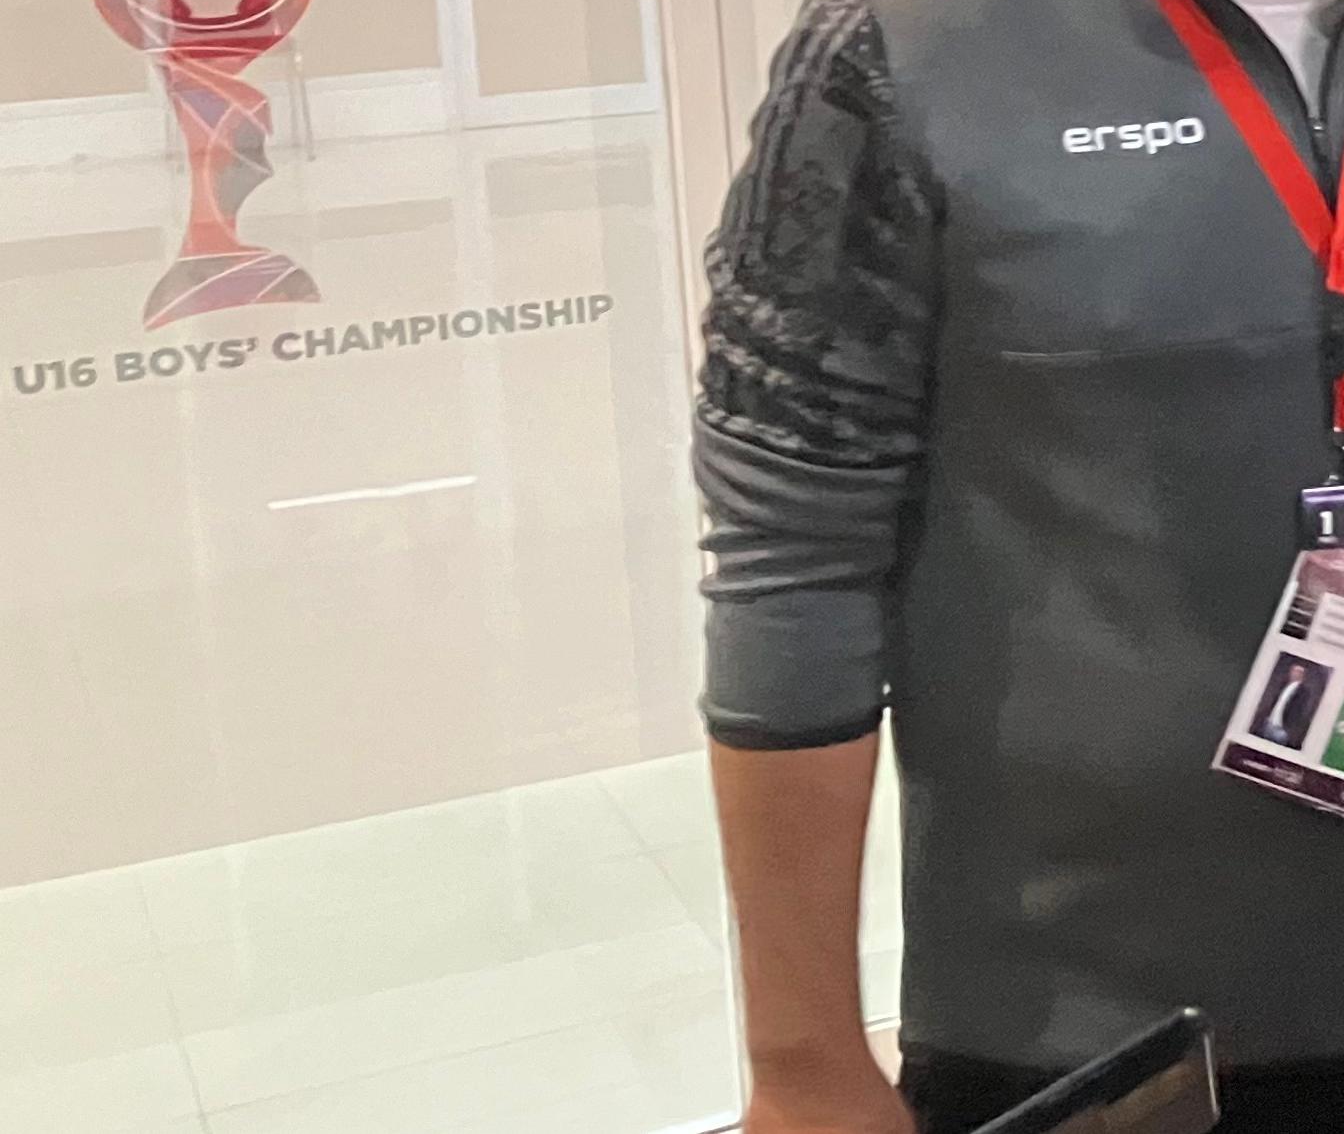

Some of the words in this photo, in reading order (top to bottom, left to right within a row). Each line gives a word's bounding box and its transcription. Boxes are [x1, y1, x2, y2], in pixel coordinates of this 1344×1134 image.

[1063, 116, 1206, 155] erspo
[12, 355, 98, 395] U16
[114, 336, 258, 383] BOYS'
[271, 292, 615, 363] CHAMPIONSHIP
